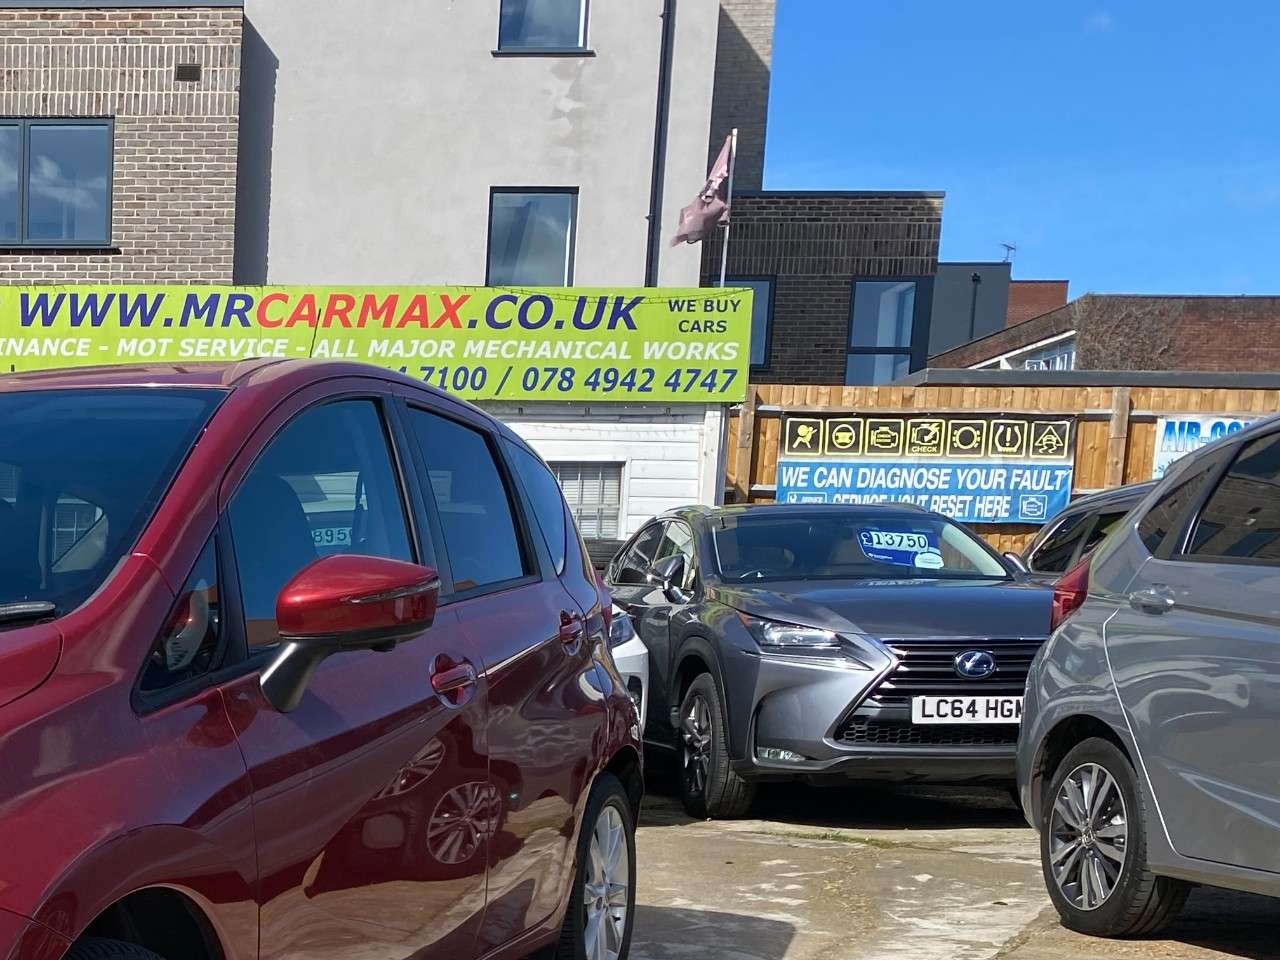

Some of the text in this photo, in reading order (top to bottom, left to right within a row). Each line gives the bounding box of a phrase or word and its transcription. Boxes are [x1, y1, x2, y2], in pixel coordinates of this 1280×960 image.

[20, 292, 645, 331] WWW.MRCARMAX.CO.UK
[668, 299, 742, 314] WE BUY
[677, 319, 729, 334] CARS
[116, 337, 173, 358] MOT
[175, 337, 288, 359] SERVICE
[315, 339, 359, 360] ALL
[367, 339, 455, 361] MAJOR
[463, 340, 632, 361] MECHANICAL
[643, 340, 739, 362] WORKS
[419, 365, 488, 392] 7100
[521, 366, 577, 393] 078
[583, 366, 656, 394] 4942
[664, 367, 738, 395] 4747
[911, 445, 938, 454] CHECK
[781, 466, 1064, 492] WE CAN DIAGNOSE YOUR FAULT
[929, 495, 976, 518] RESET
[975, 495, 1012, 518] HERE
[860, 531, 928, 549] £13750
[921, 698, 979, 719] LC64
